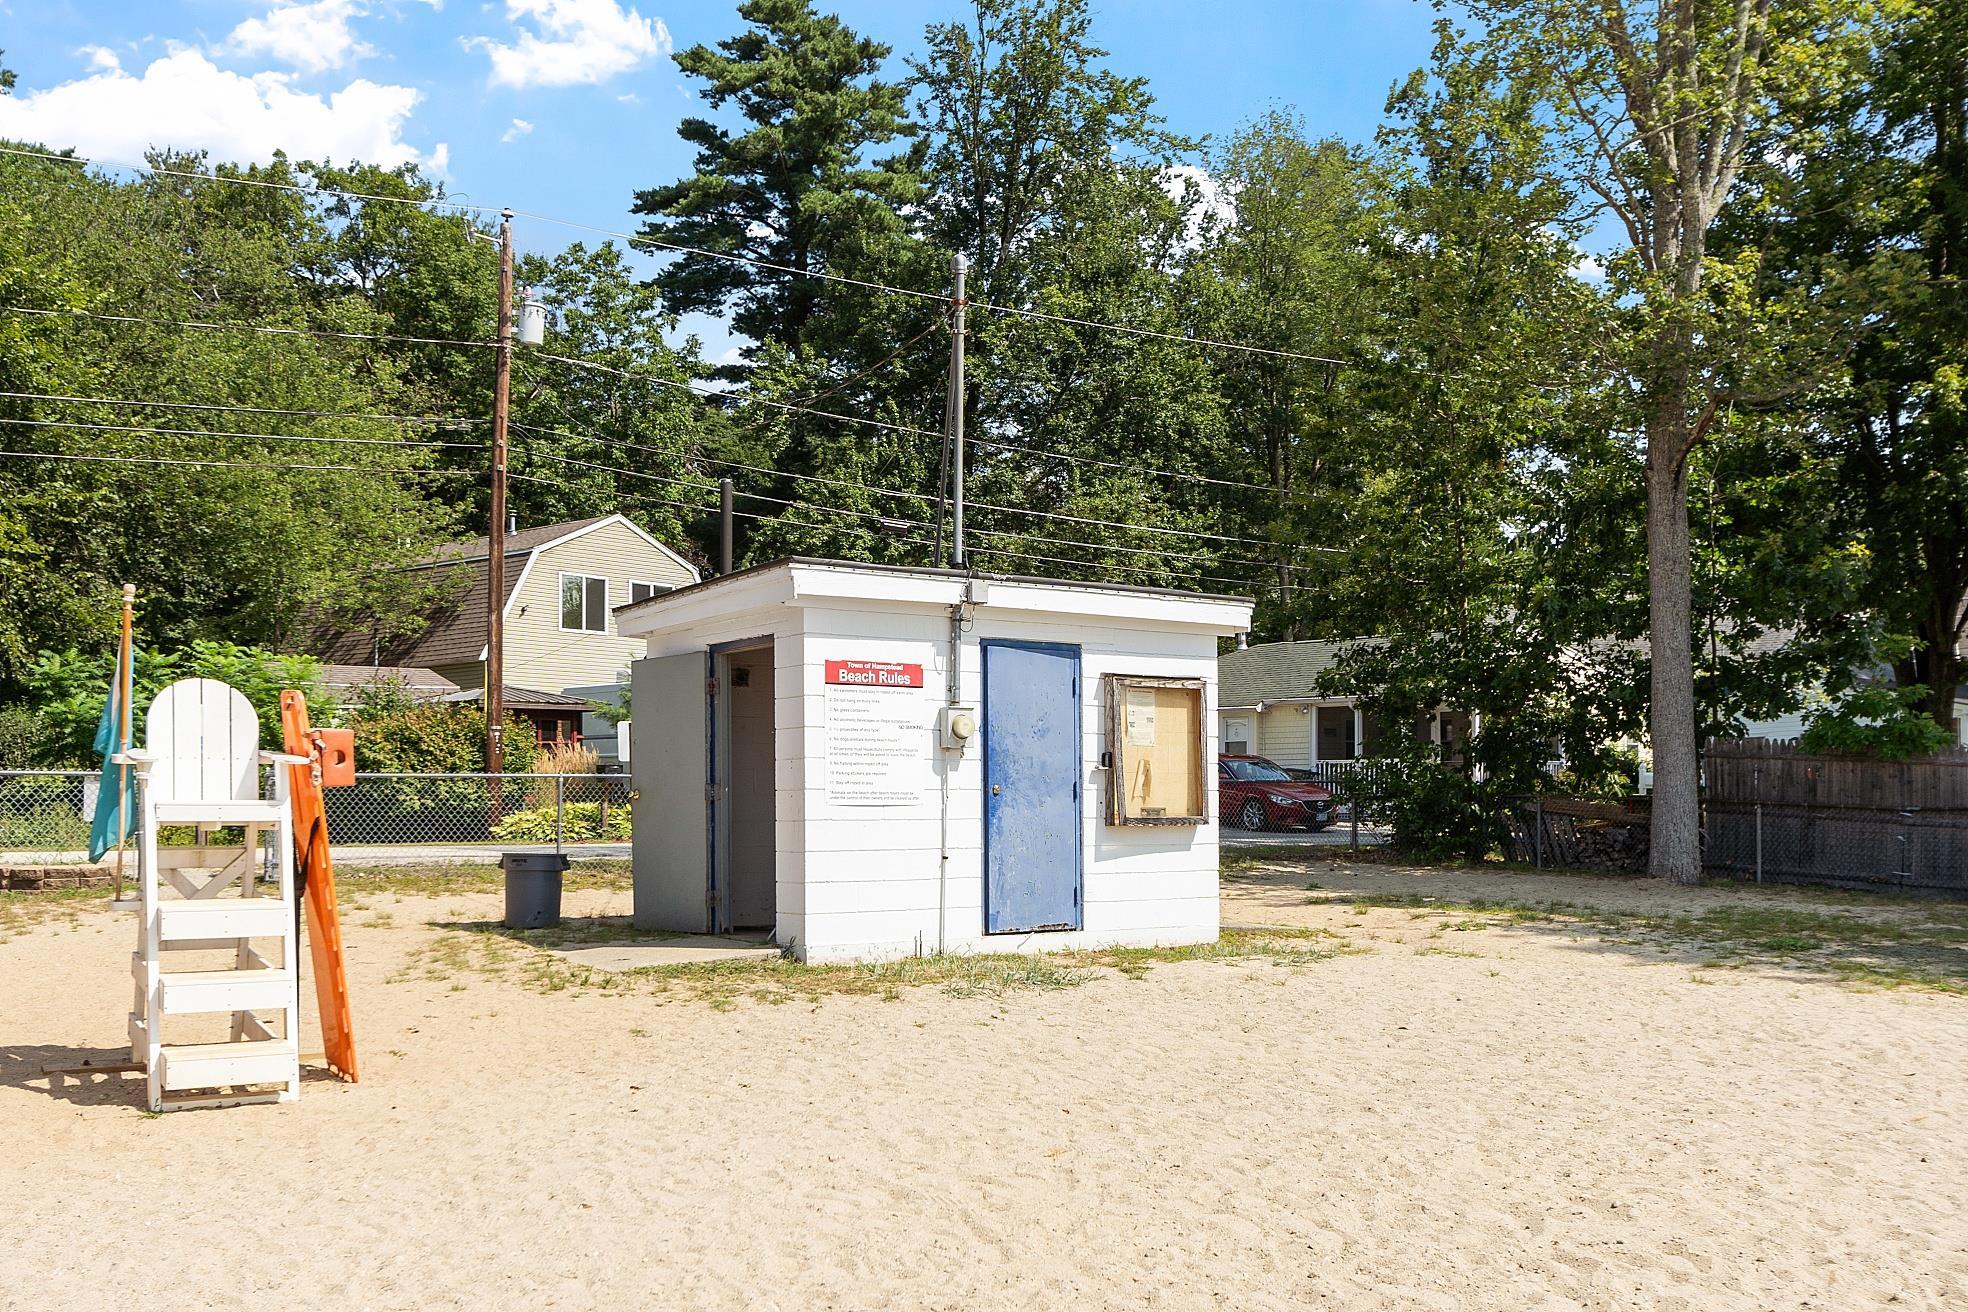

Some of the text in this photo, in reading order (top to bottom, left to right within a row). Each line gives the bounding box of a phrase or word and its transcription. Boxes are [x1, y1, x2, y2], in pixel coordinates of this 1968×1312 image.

[872, 663, 904, 671] Hampstead
[839, 668, 911, 684] Beach Rules
